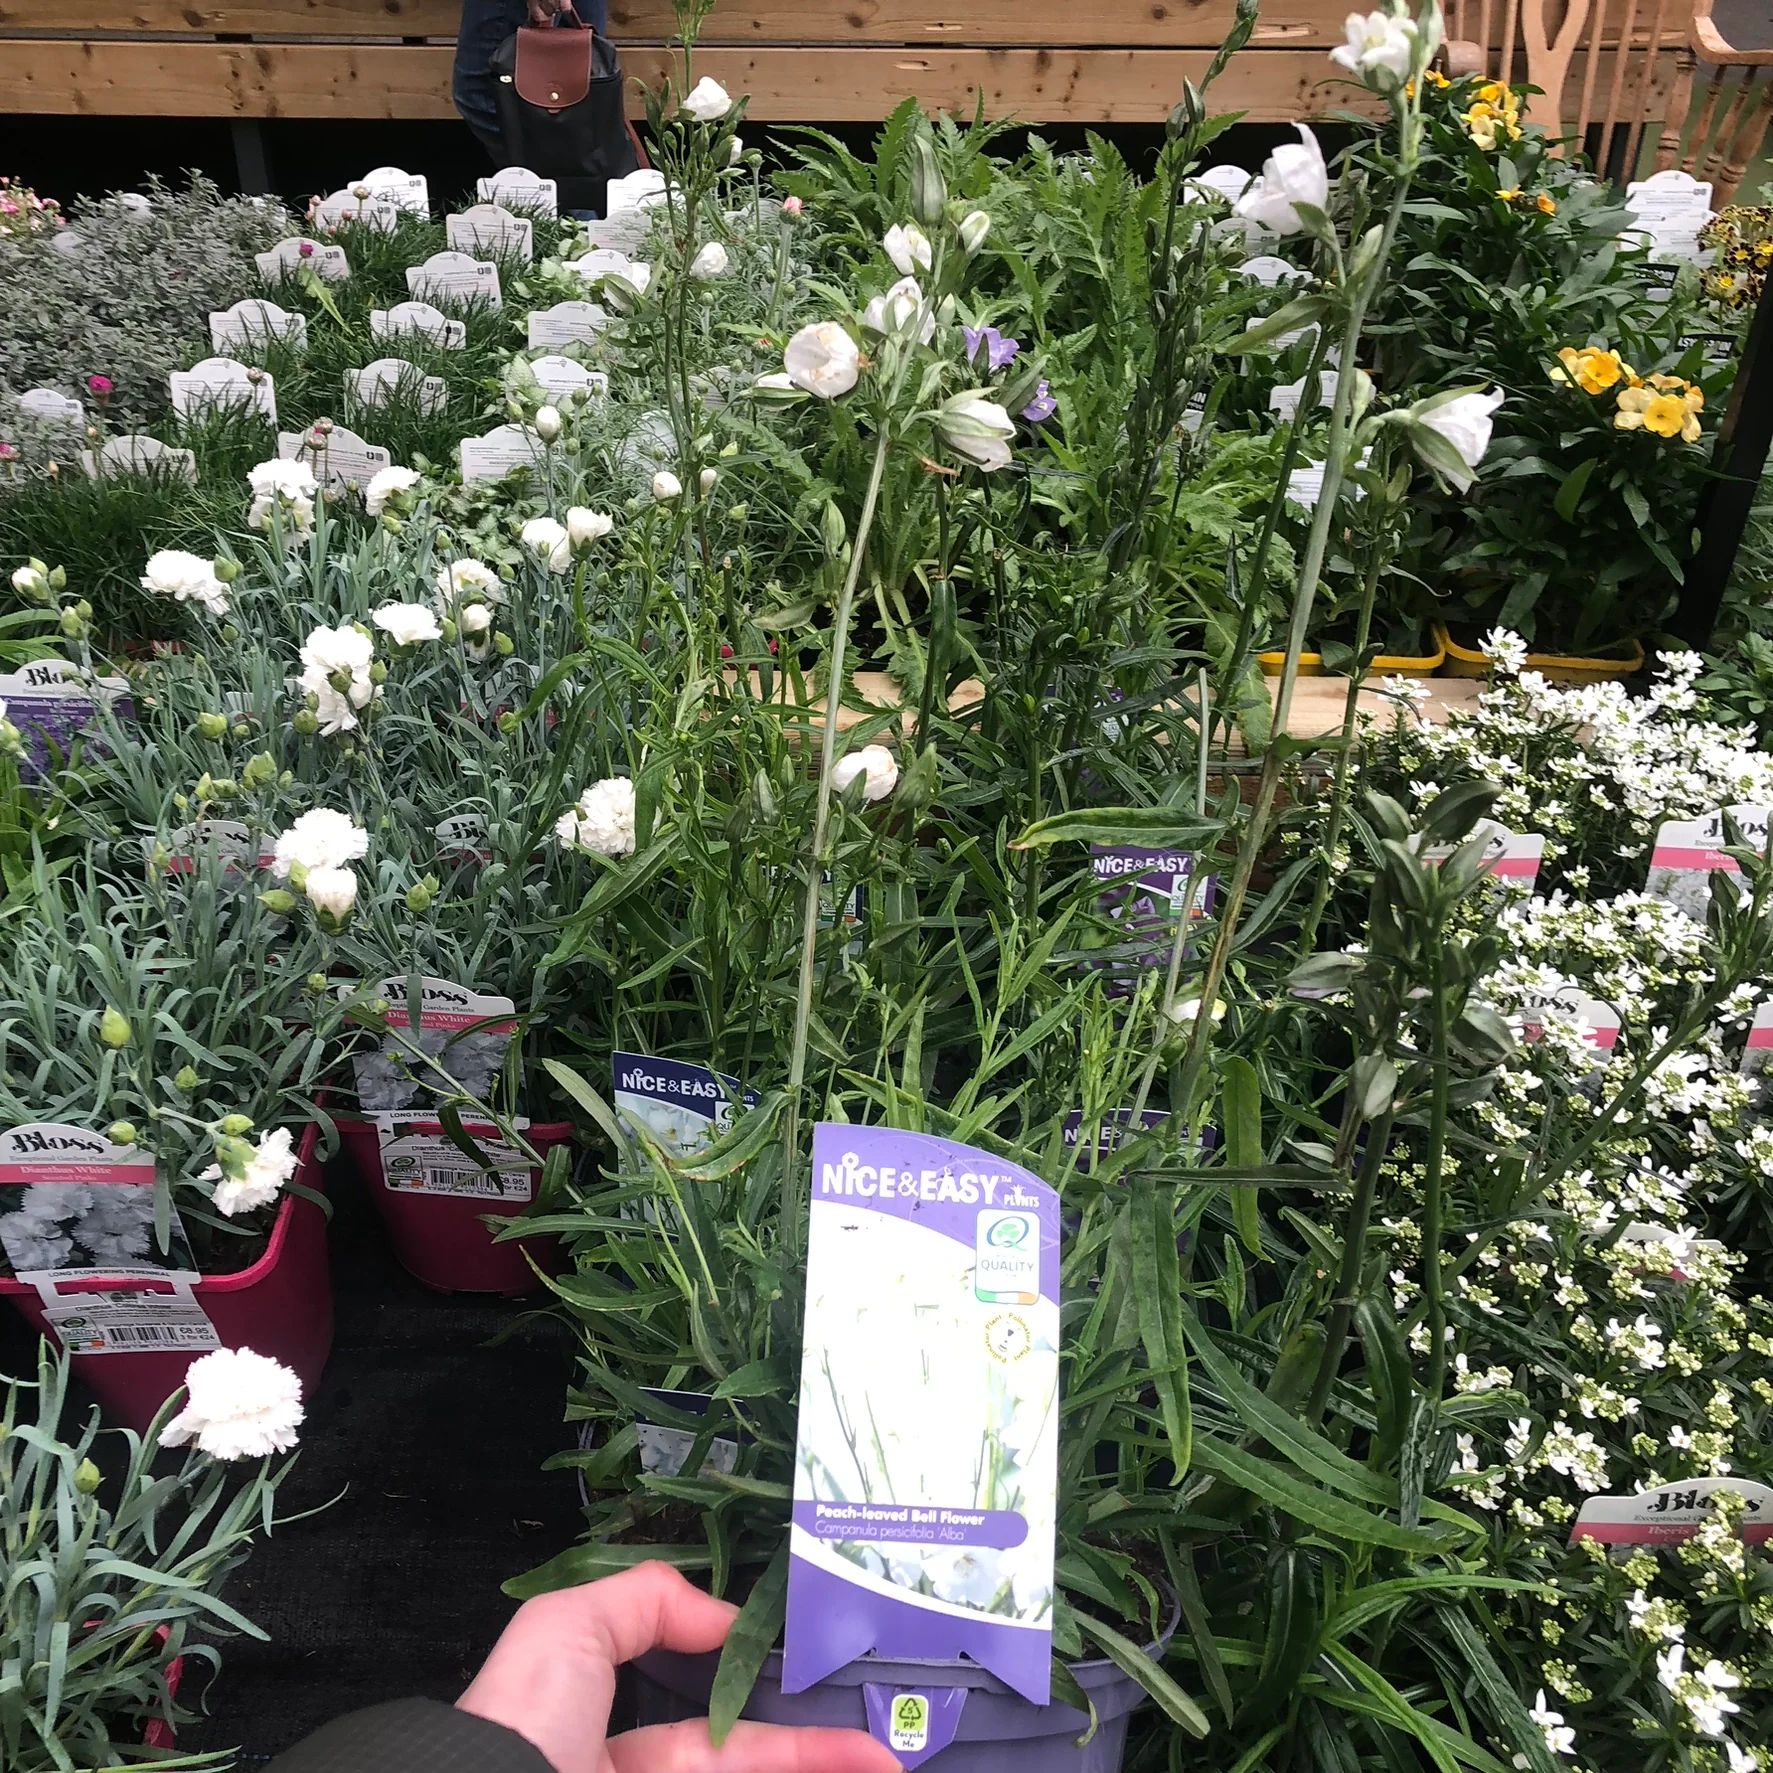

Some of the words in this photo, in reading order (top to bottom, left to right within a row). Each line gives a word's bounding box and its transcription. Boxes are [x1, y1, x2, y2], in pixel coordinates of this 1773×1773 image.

[12, 1131, 105, 1154] Bloss
[20, 1166, 74, 1175] Dianthus
[77, 1166, 112, 1175] White
[981, 1259, 1034, 1272] QUALITY
[1647, 1489, 1763, 1513] Blos
[816, 1504, 908, 1522] Peach-leaved
[911, 1509, 937, 1524] Bell
[940, 1511, 986, 1526] Flower
[814, 1519, 878, 1539] Campanula
[880, 1524, 934, 1540] persicifolia
[894, 1729, 925, 1740] Recycle
[902, 1740, 915, 1748] Me
